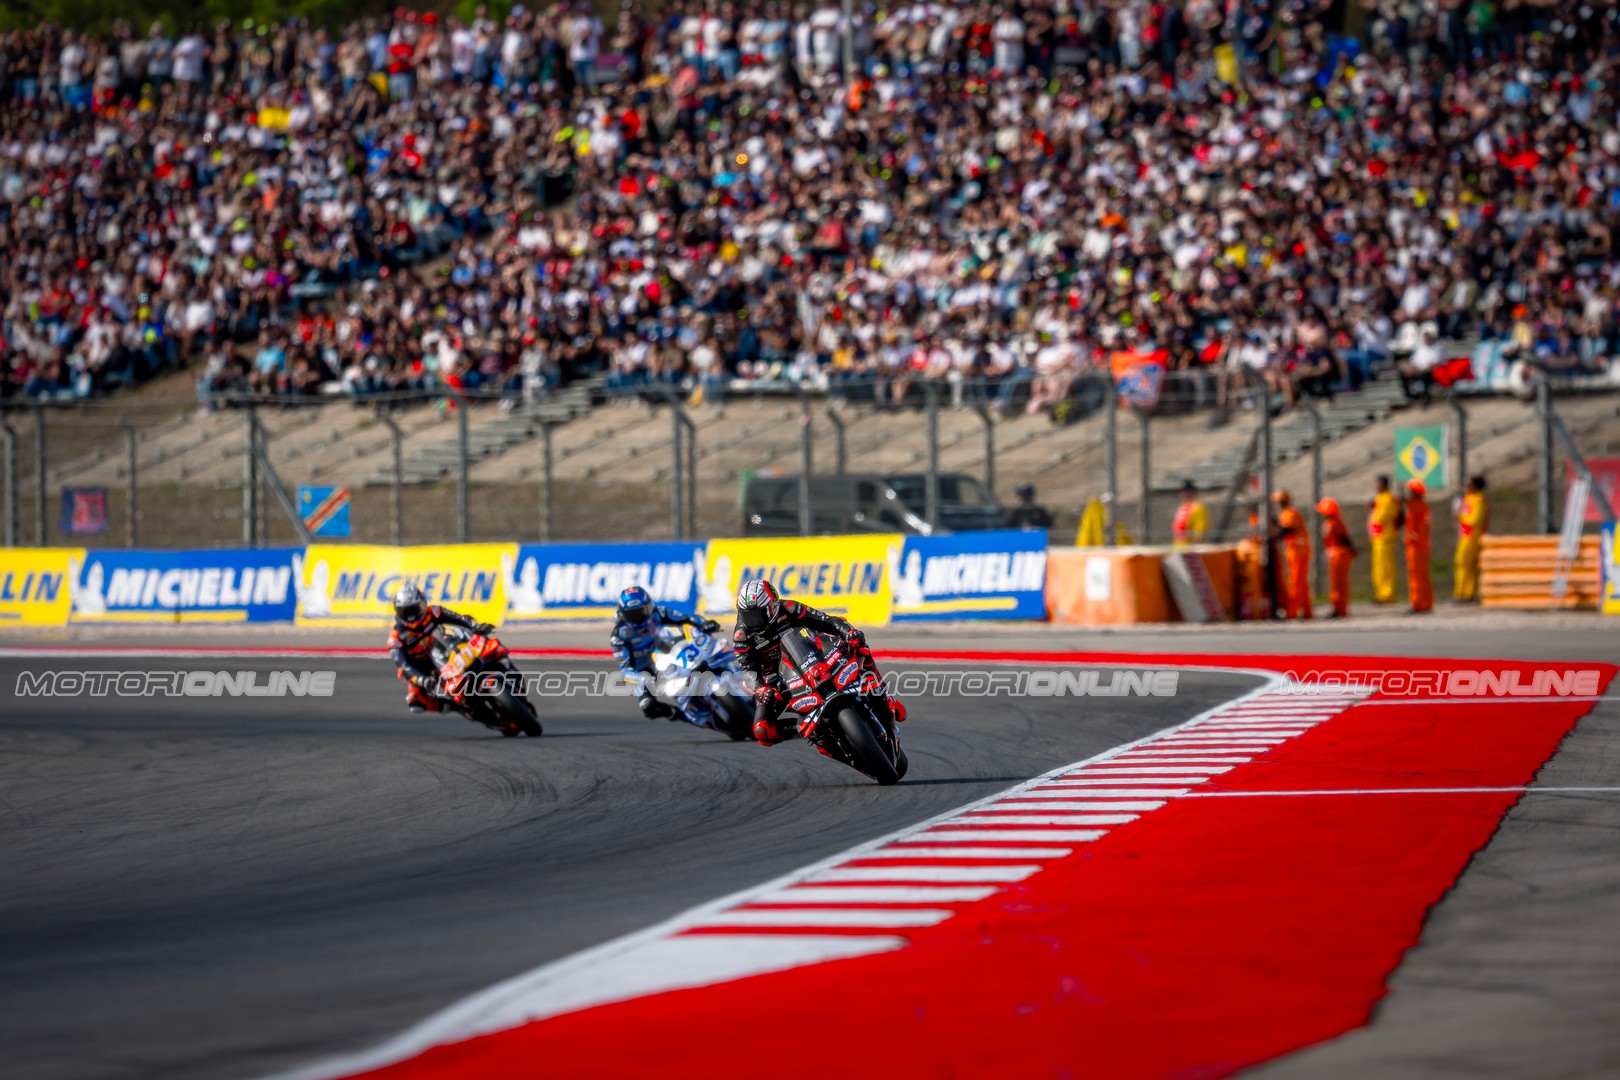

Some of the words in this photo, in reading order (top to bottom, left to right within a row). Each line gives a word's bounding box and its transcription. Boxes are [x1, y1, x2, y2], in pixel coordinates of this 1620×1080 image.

[0, 571, 62, 601] LIN
[106, 565, 291, 607] MICHELIN
[923, 551, 1047, 596] MICHELIN
